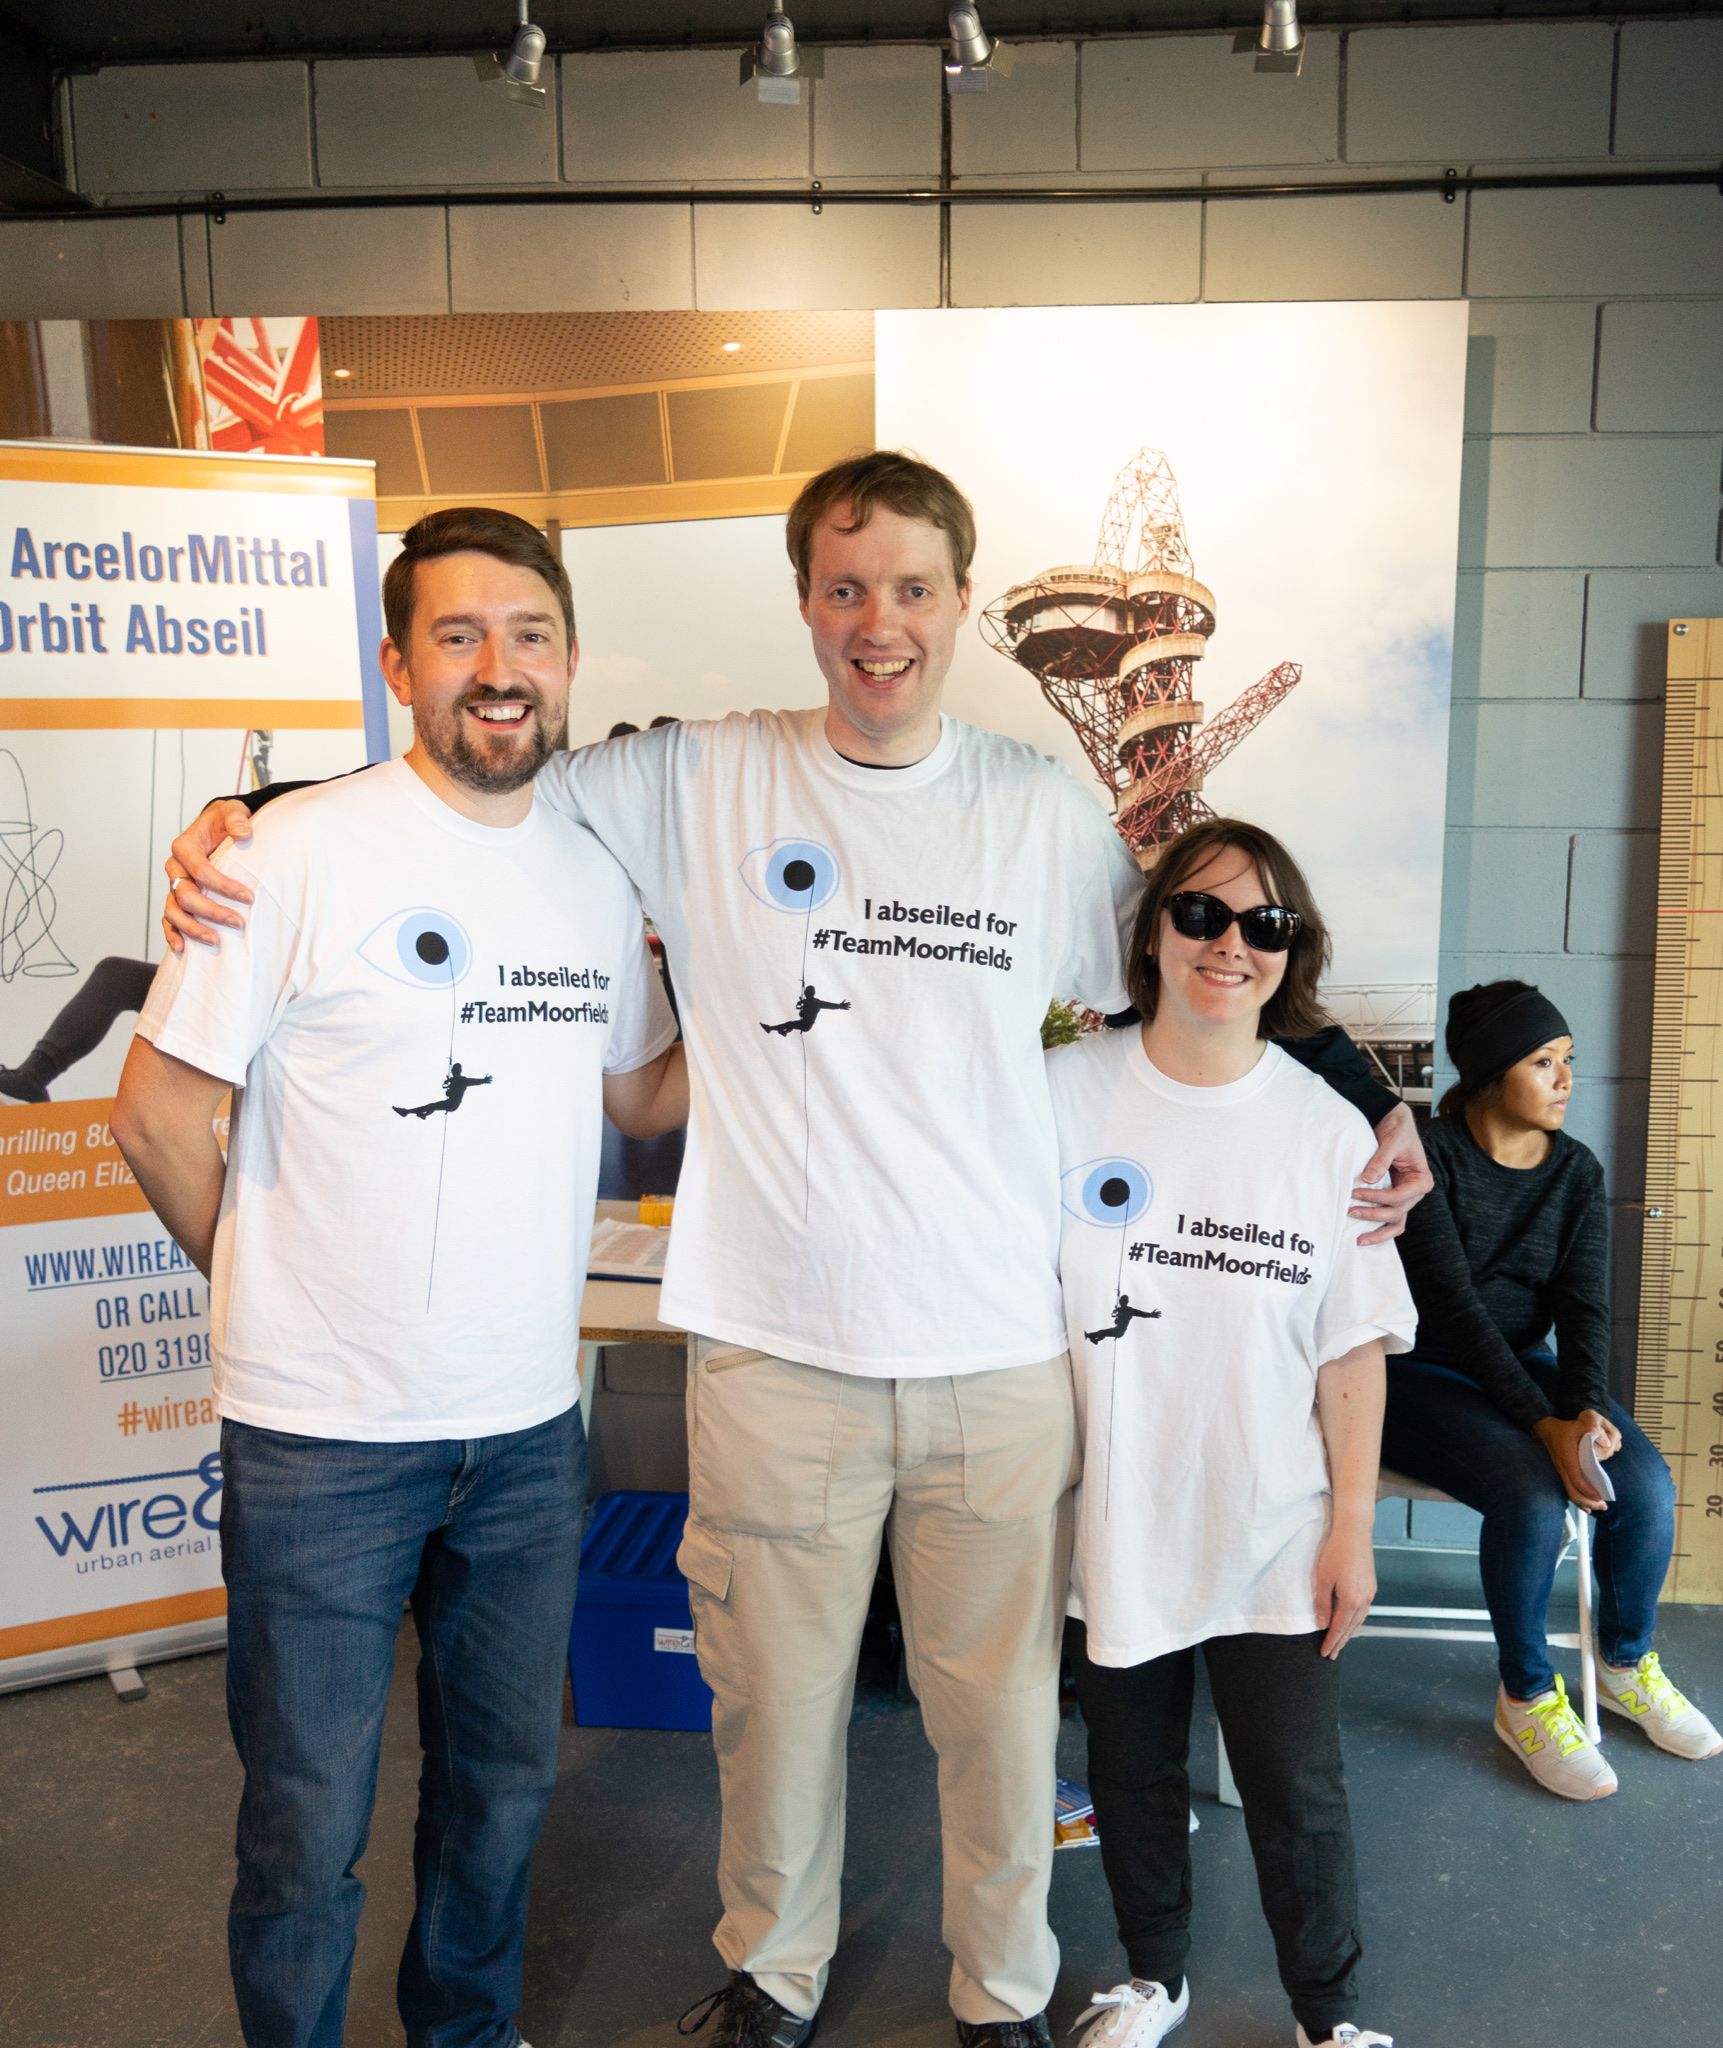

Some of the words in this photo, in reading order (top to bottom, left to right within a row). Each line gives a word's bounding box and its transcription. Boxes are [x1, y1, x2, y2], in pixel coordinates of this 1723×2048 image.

[11, 527, 328, 588] ArcelorMittal
[126, 604, 267, 656] Abseil
[864, 899, 872, 920] I
[877, 900, 982, 930] abseiled
[986, 913, 1018, 937] for
[812, 929, 1013, 972] #TeamMoorfields
[498, 965, 505, 986] I
[511, 965, 590, 989] abseiled
[593, 969, 610, 991] for
[460, 1001, 609, 1025] #TeamMoorfields
[7, 1169, 86, 1196] Queen
[1177, 1213, 1186, 1234] I
[1190, 1217, 1285, 1250] abseiled
[1290, 1232, 1315, 1257] for
[25, 1239, 191, 1286] WWW.WIREA
[1128, 1242, 1313, 1286] #TeamMoorfields
[96, 1295, 131, 1330] OR
[139, 1287, 201, 1325] CALL
[99, 1341, 147, 1378] 020
[118, 1396, 221, 1437] #wirea
[1708, 1444, 1723, 1468] 30
[1705, 1494, 1723, 1519] 20
[76, 1552, 143, 1575] urban
[150, 1535, 212, 1562] aerial
